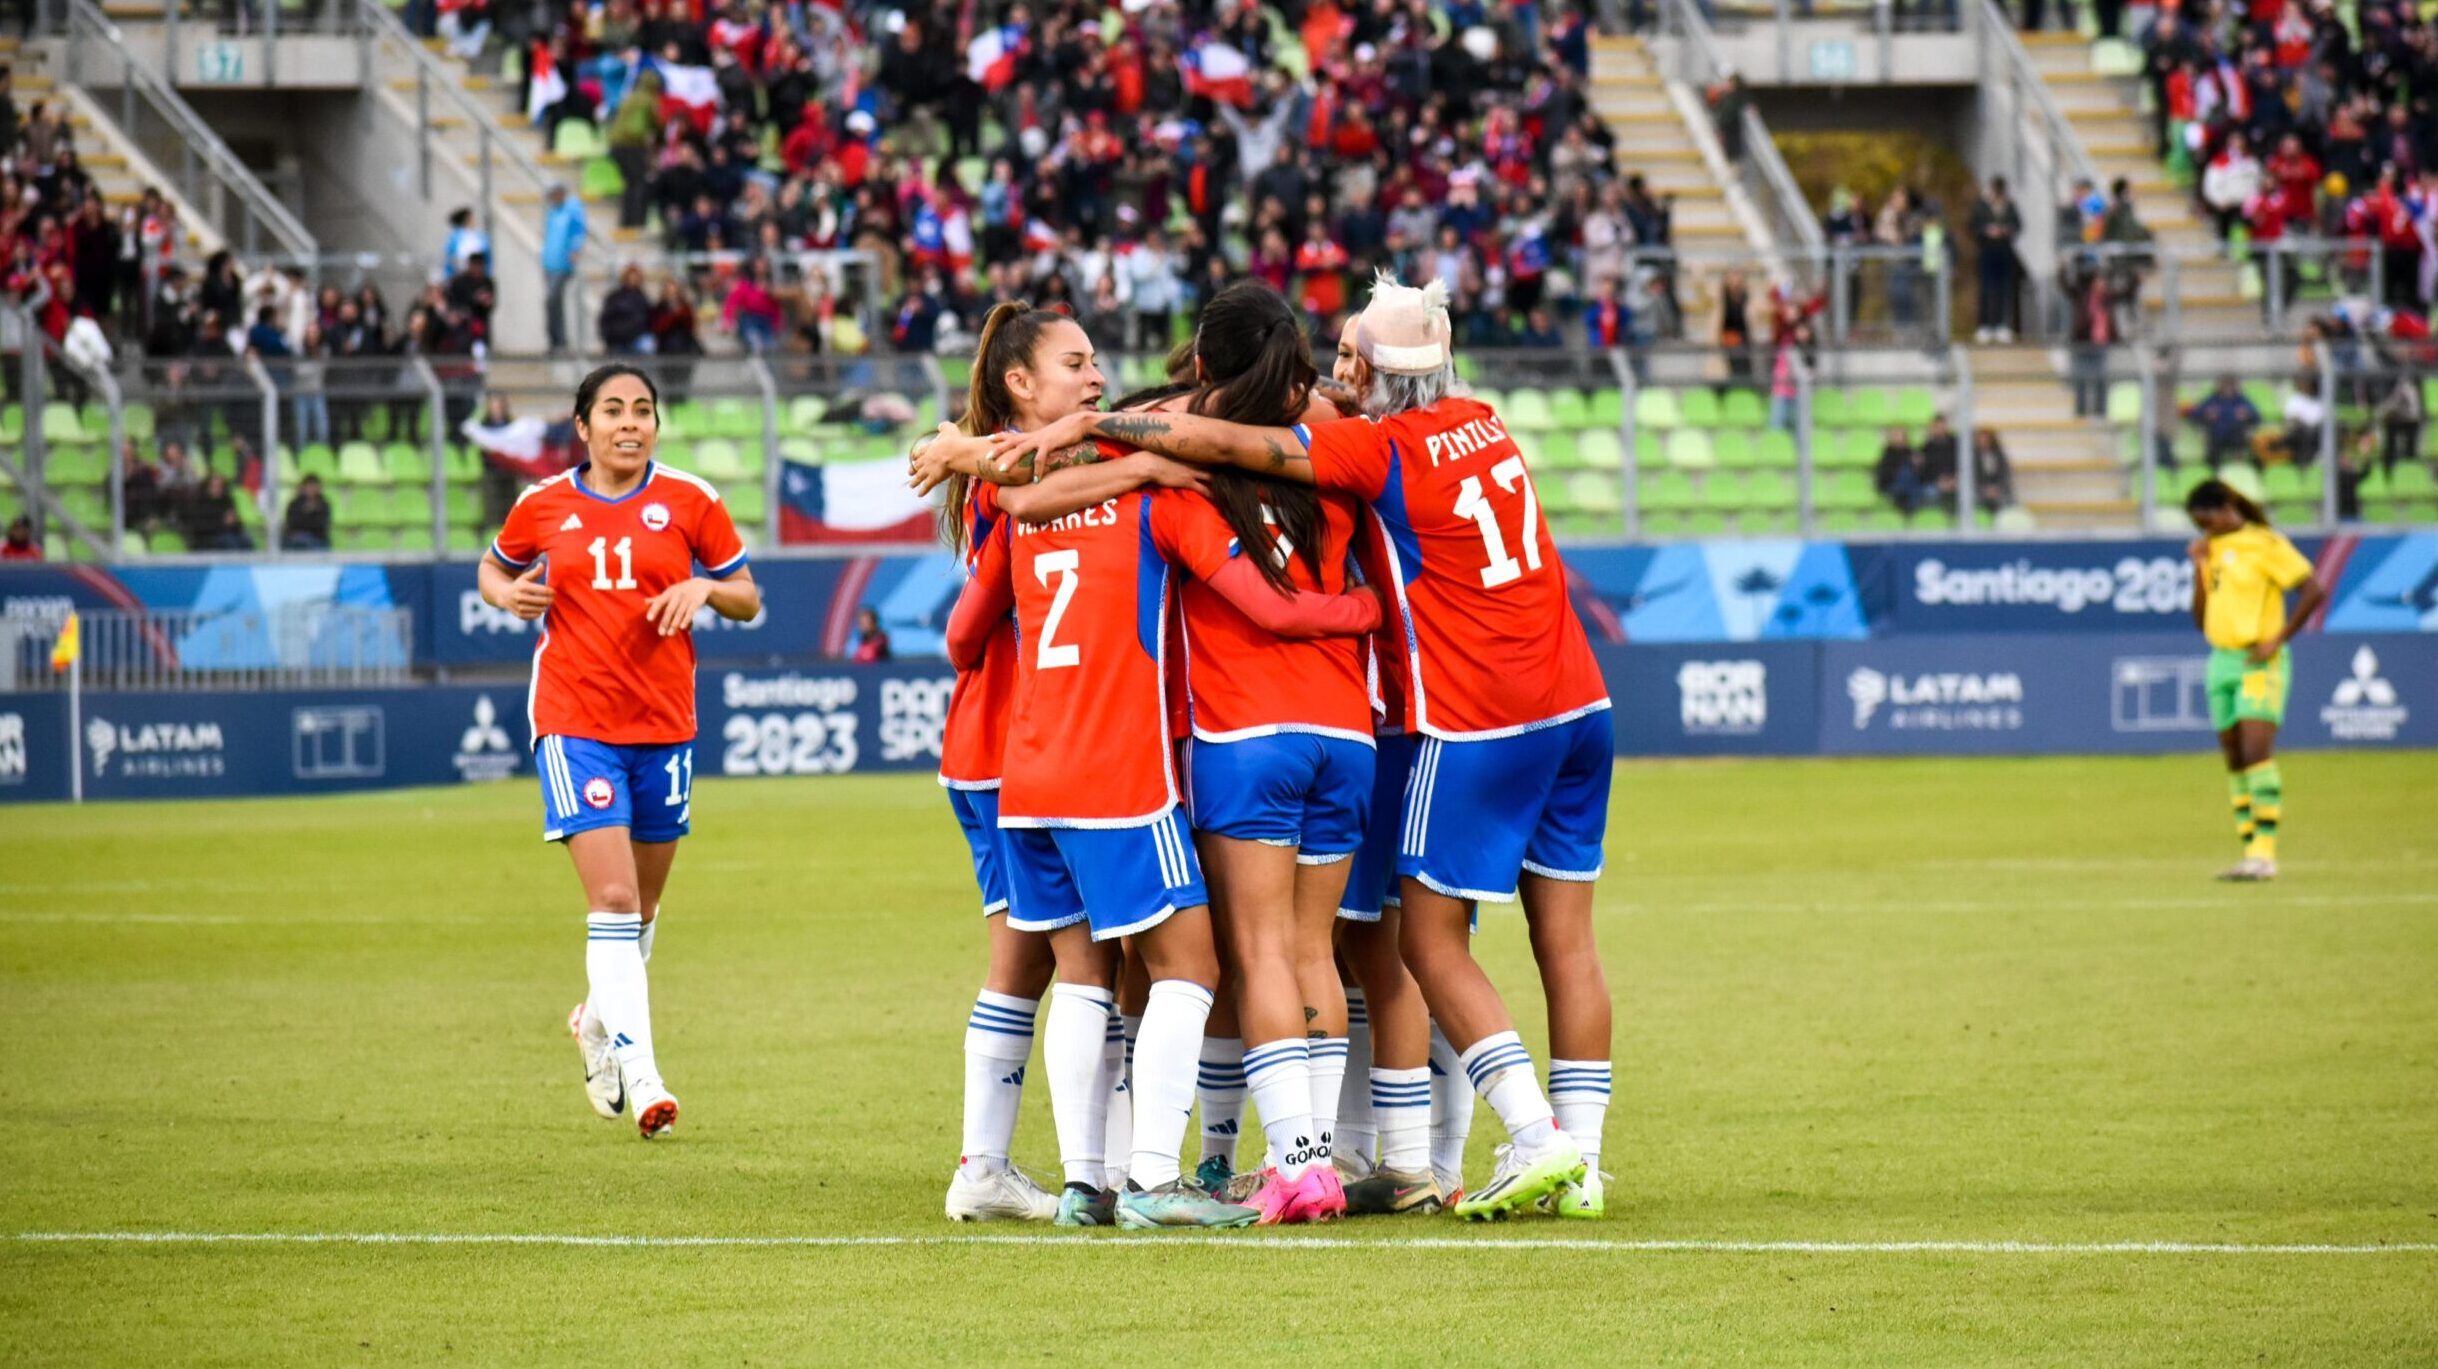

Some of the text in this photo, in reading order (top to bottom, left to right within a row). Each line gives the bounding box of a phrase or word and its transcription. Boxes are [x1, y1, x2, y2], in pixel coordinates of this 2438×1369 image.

[1425, 416, 1506, 467] PINILL
[1453, 455, 1542, 588] 17
[587, 536, 637, 590] 11
[1915, 557, 2196, 613] Santiago 202
[1034, 549, 1079, 669] 2
[723, 672, 858, 712] Santiago
[1890, 673, 2023, 704] LATAM
[119, 722, 224, 752] LATAM
[723, 713, 858, 775] 2023
[664, 748, 693, 806] 11
